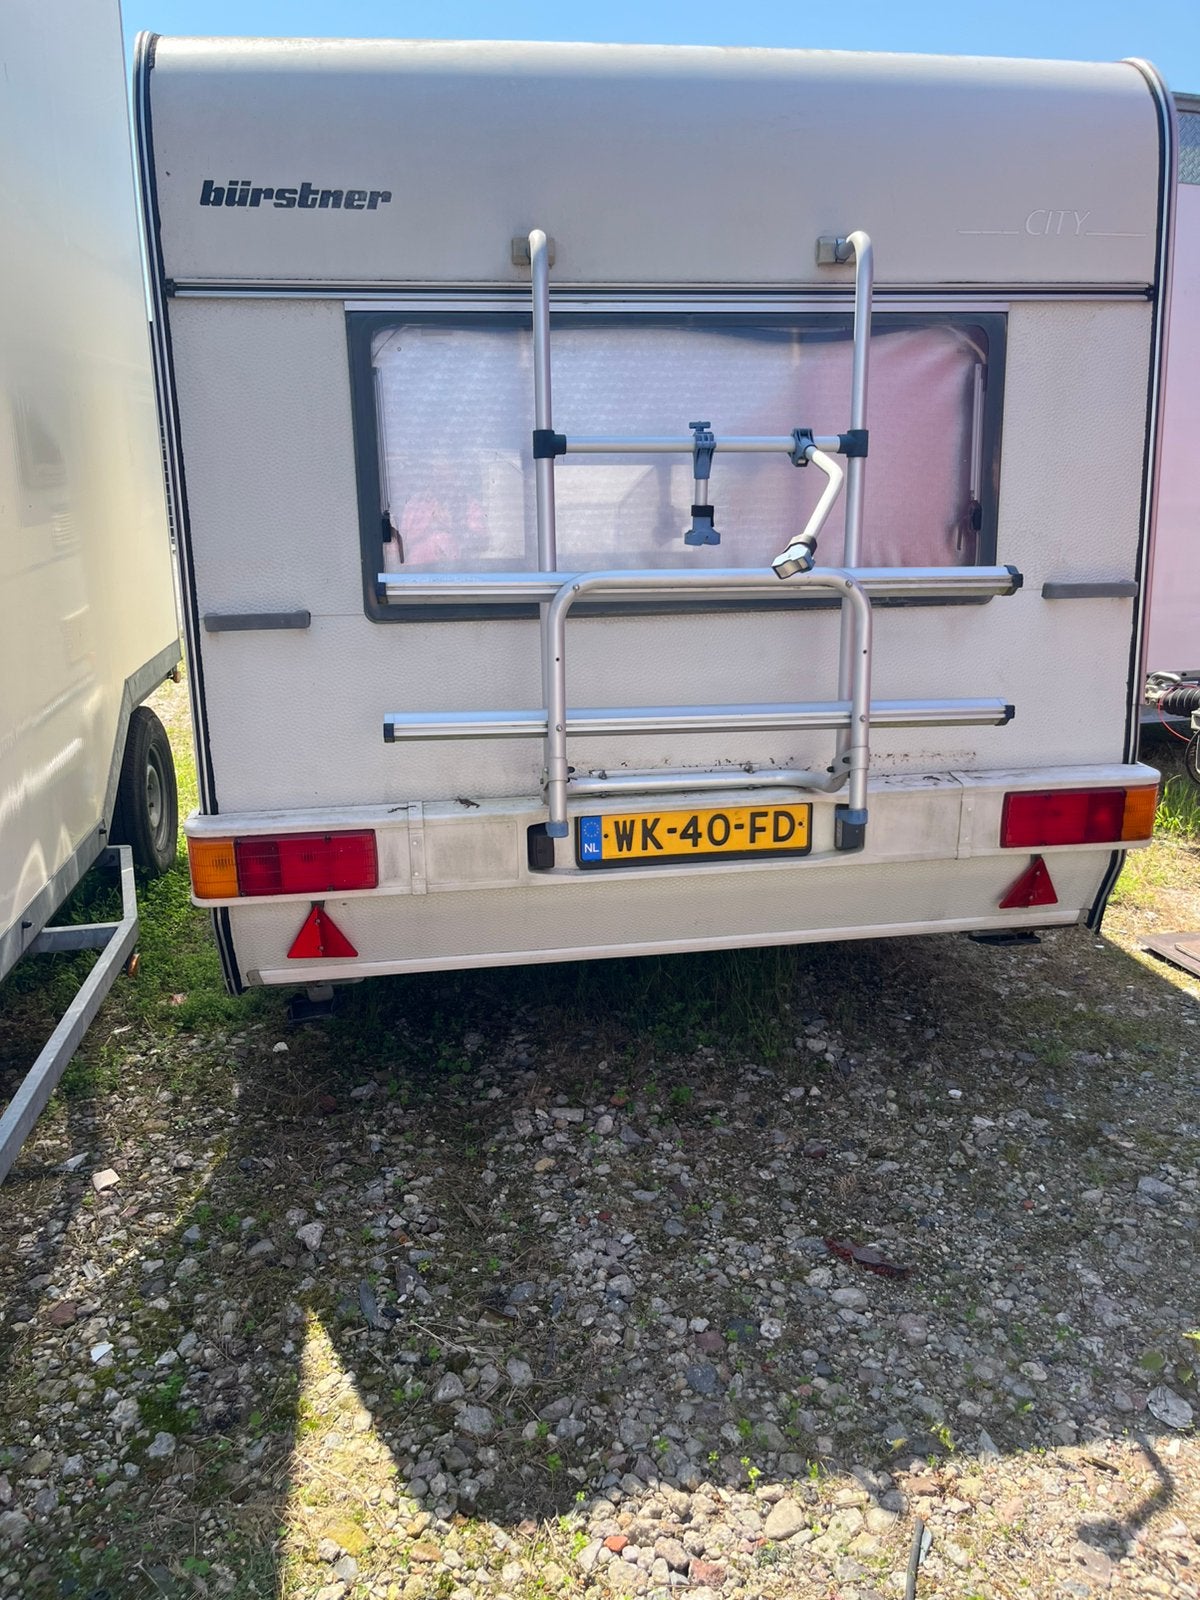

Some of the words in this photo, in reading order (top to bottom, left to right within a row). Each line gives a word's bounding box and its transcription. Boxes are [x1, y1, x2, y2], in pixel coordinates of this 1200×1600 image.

[200, 179, 392, 210] bürstner
[1025, 209, 1091, 236] CITY
[614, 810, 796, 852] WK-40-FD
[584, 843, 599, 854] NL
